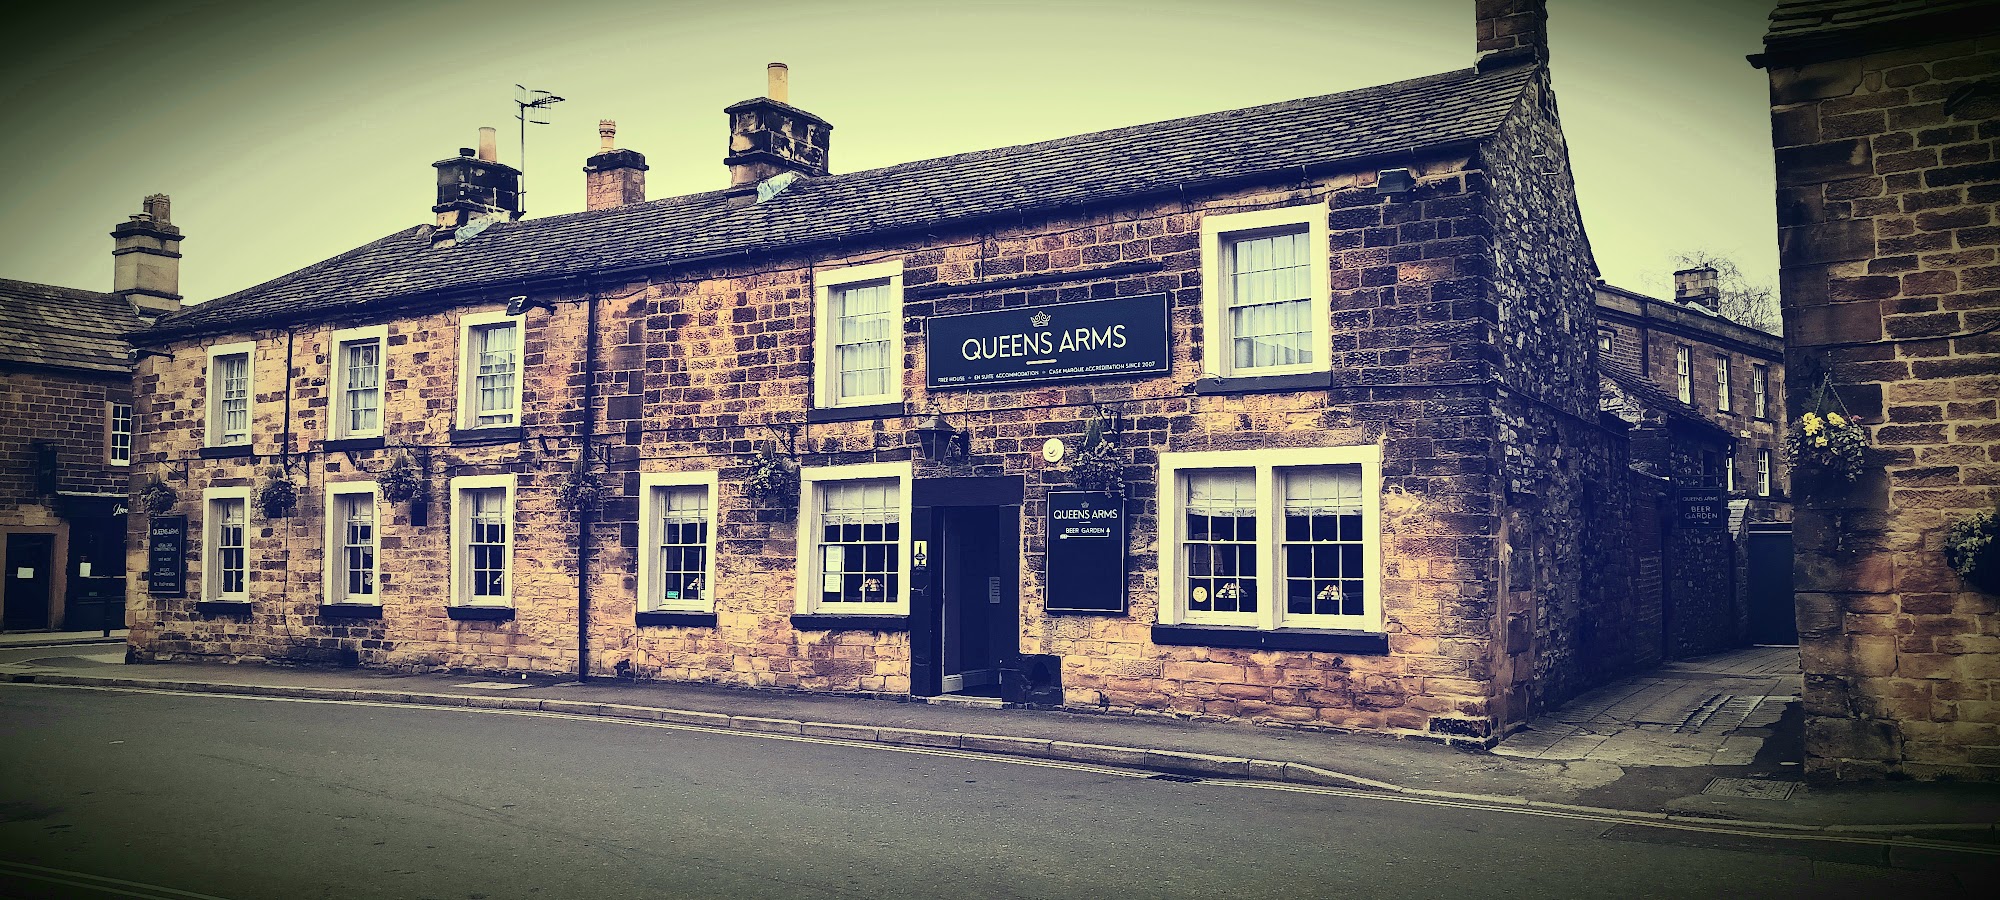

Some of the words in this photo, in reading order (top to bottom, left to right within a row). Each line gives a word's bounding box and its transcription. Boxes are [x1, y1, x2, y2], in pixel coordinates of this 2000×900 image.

[961, 331, 1053, 361] QUEENS
[1058, 324, 1127, 353] ARMS
[995, 370, 1039, 379] ACCOMMODATION
[1062, 366, 1085, 374] MARQUE
[1085, 363, 1124, 372] ACCREDITATION
[1125, 361, 1141, 369] SINCE
[1141, 360, 1156, 368] 2007
[1053, 510, 1090, 520] QUEENS
[1091, 509, 1118, 519] ARMS
[1691, 505, 1711, 513] BEER
